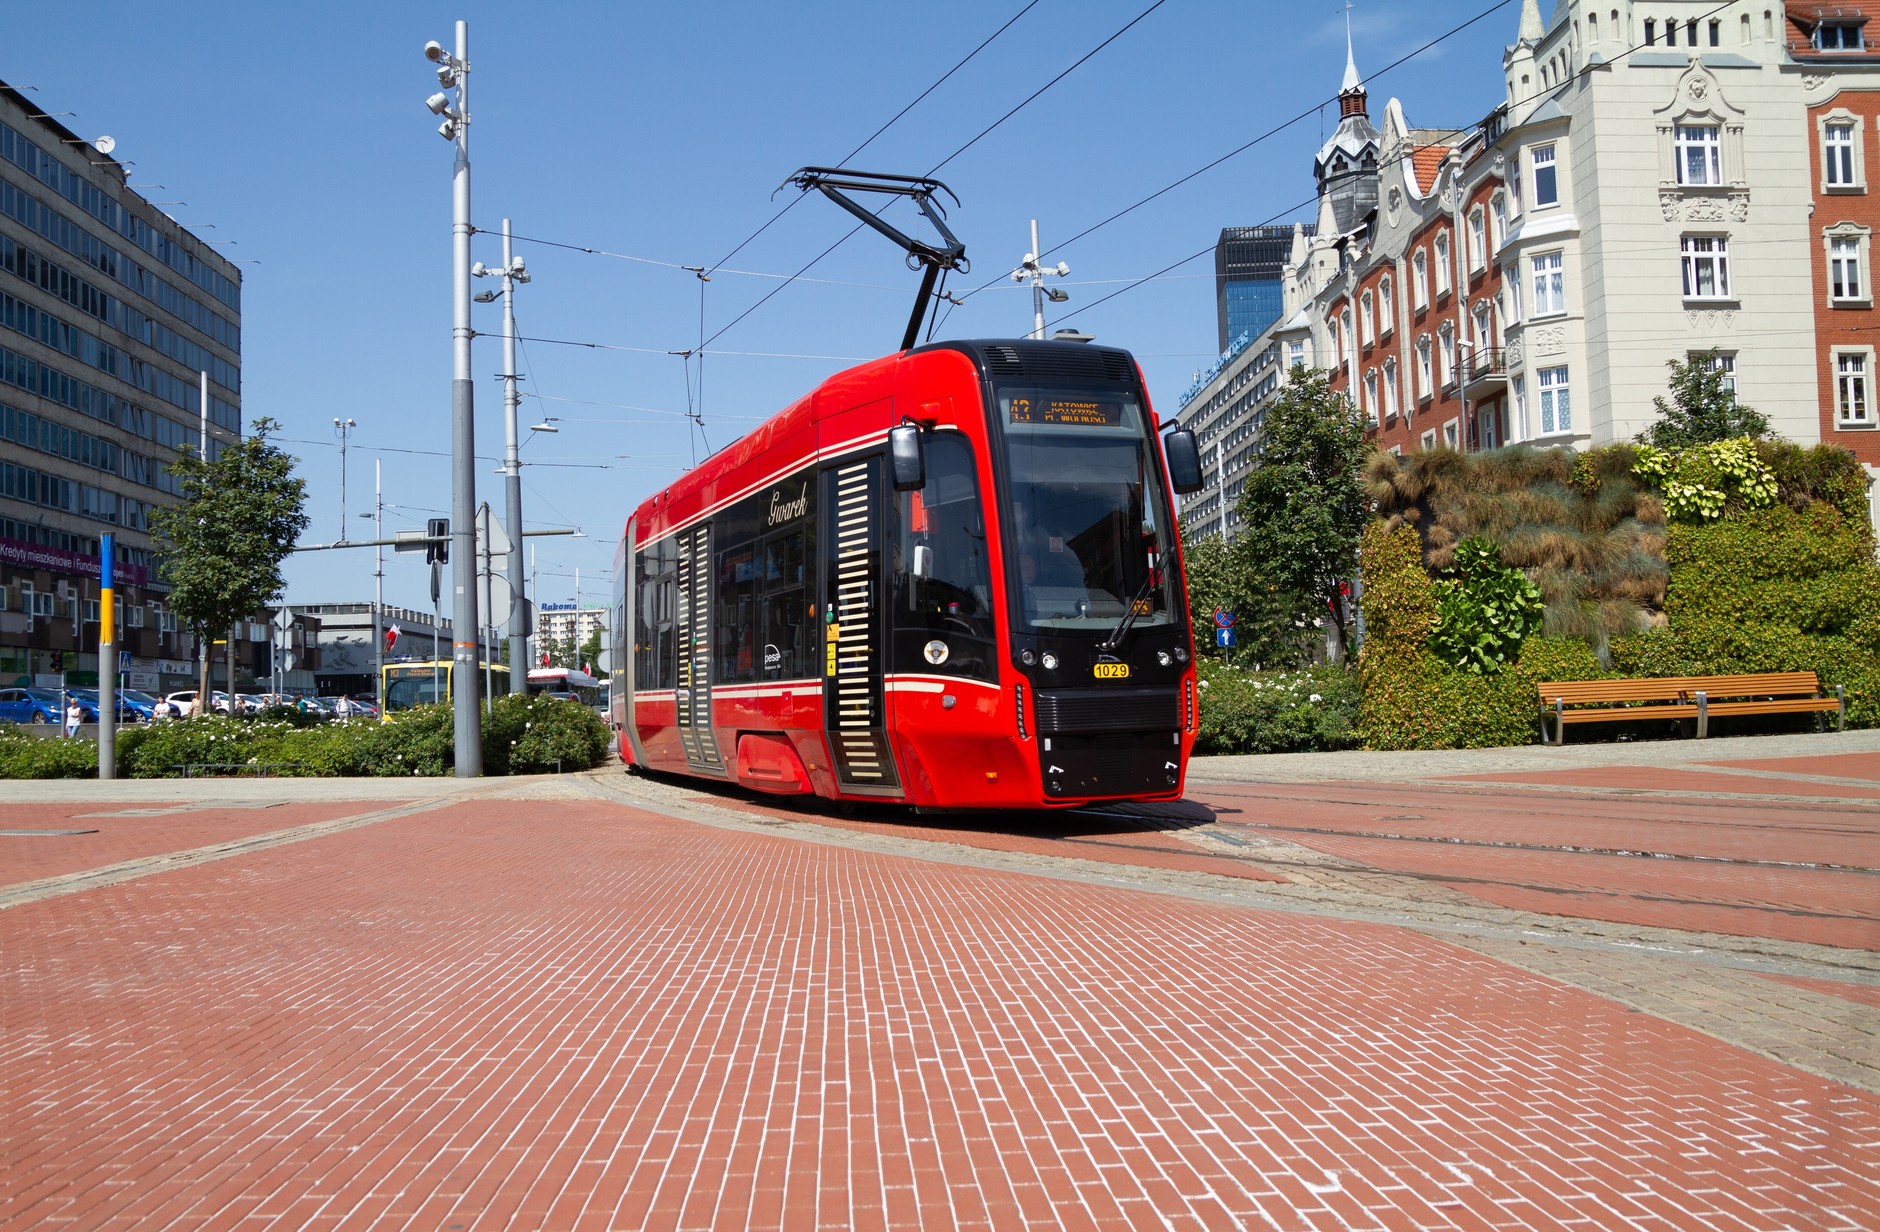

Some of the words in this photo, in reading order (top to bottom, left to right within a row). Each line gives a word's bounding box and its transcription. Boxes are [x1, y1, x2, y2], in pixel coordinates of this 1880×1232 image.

[1010, 399, 1030, 422] 43
[1051, 402, 1099, 414] KATOWICE
[768, 482, 808, 526] Gwarek
[0, 543, 27, 562] Kredyty
[27, 550, 72, 568] mieszkaniowe
[541, 602, 577, 611] Bakoma
[1096, 665, 1127, 677] 1029
